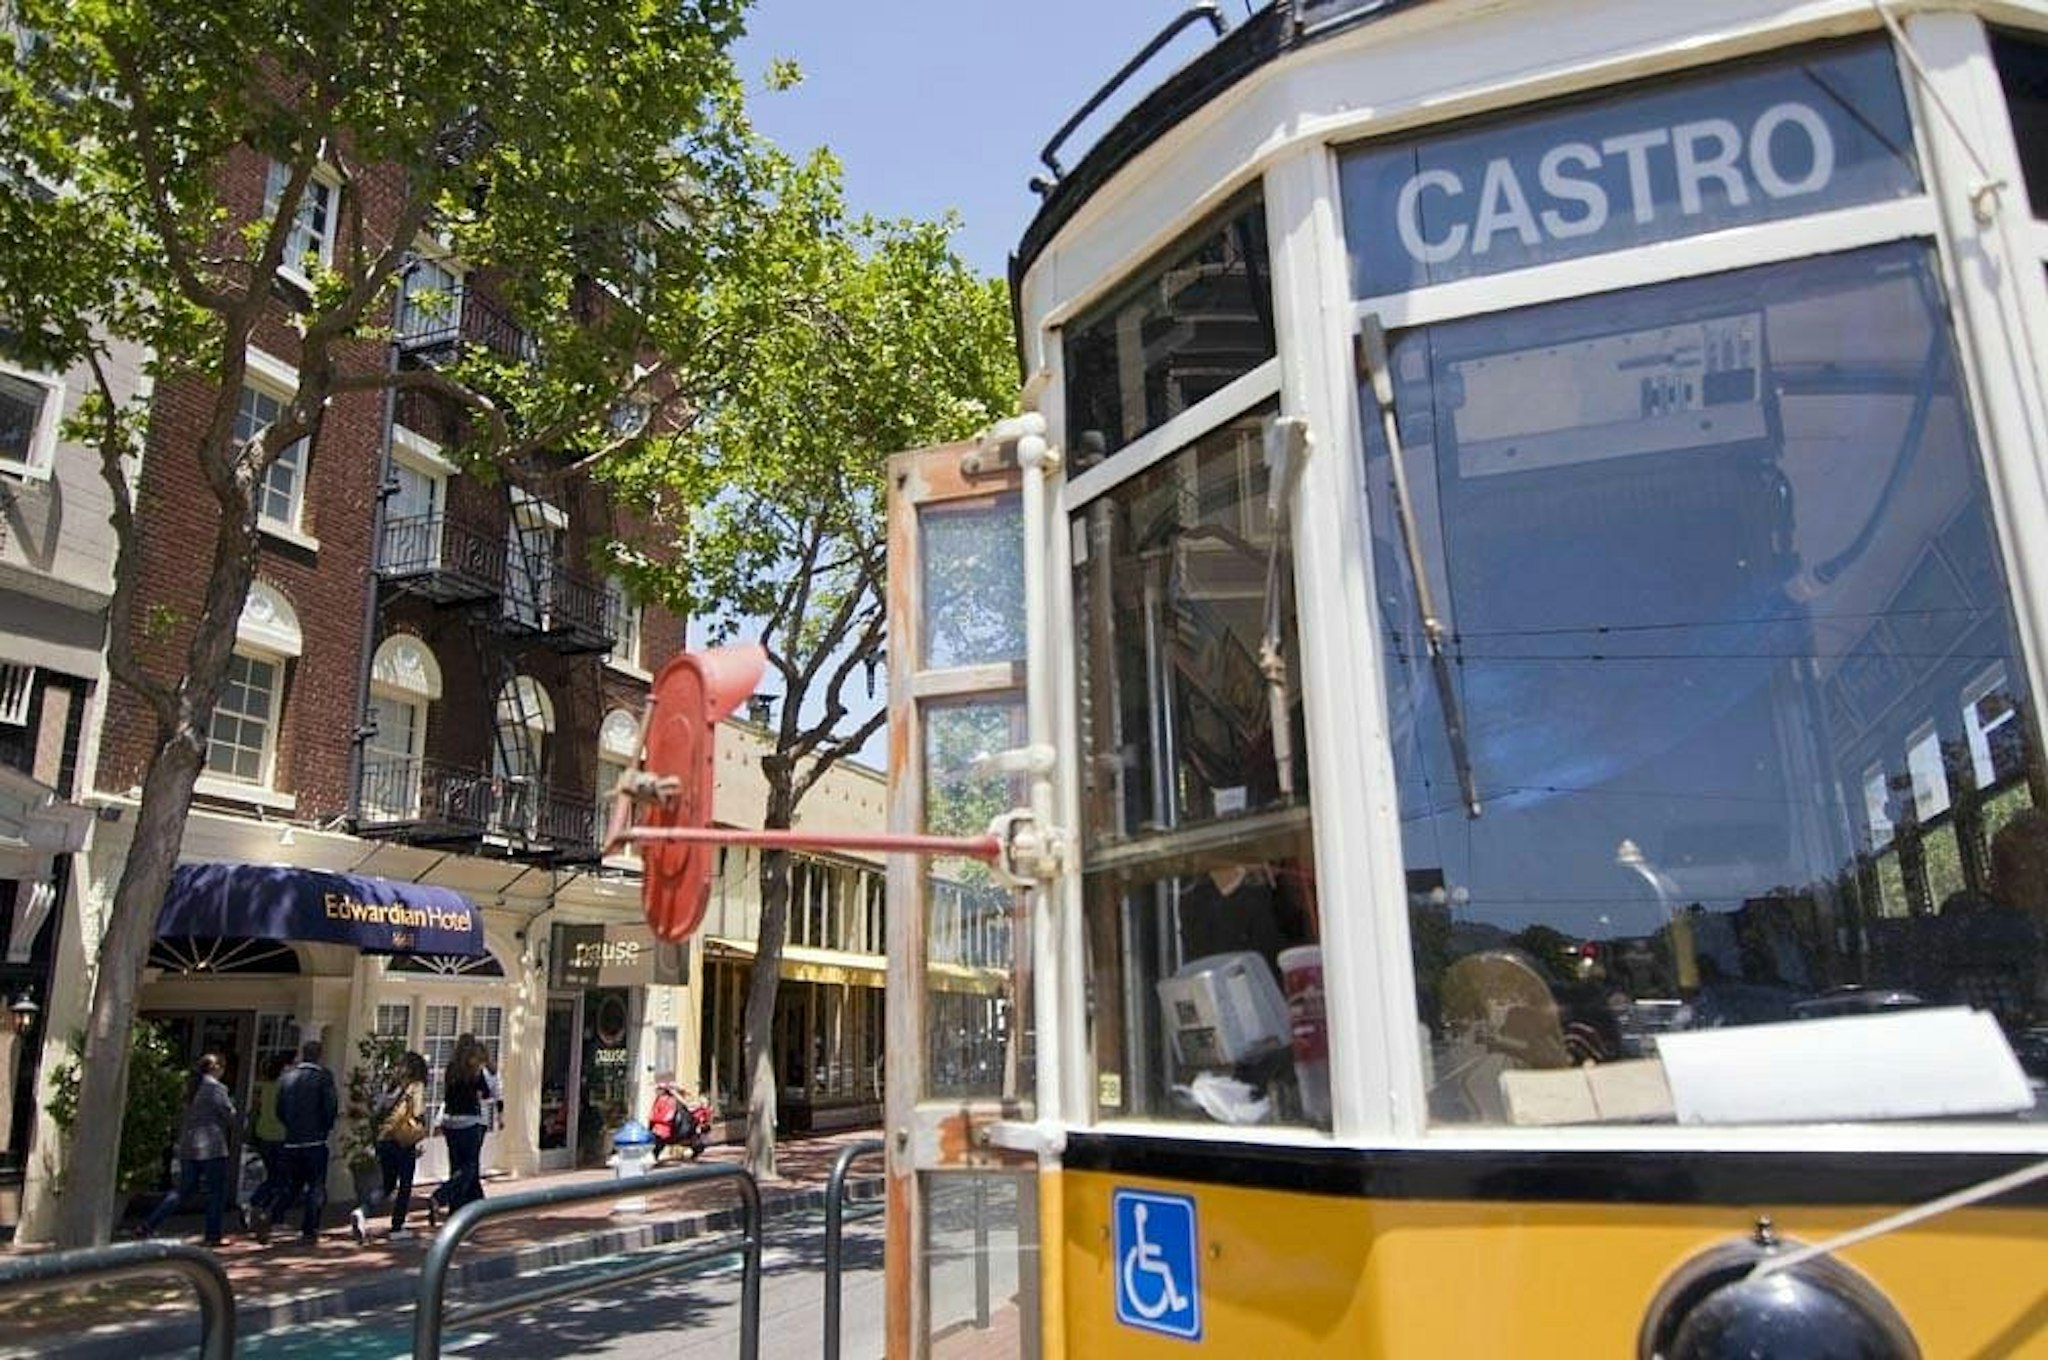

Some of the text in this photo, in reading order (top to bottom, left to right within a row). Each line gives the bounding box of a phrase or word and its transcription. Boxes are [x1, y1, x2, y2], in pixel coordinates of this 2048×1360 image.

[1397, 102, 1835, 263] CASTRO
[325, 893, 472, 931] Edwardian Hotel
[576, 940, 640, 962] pause
